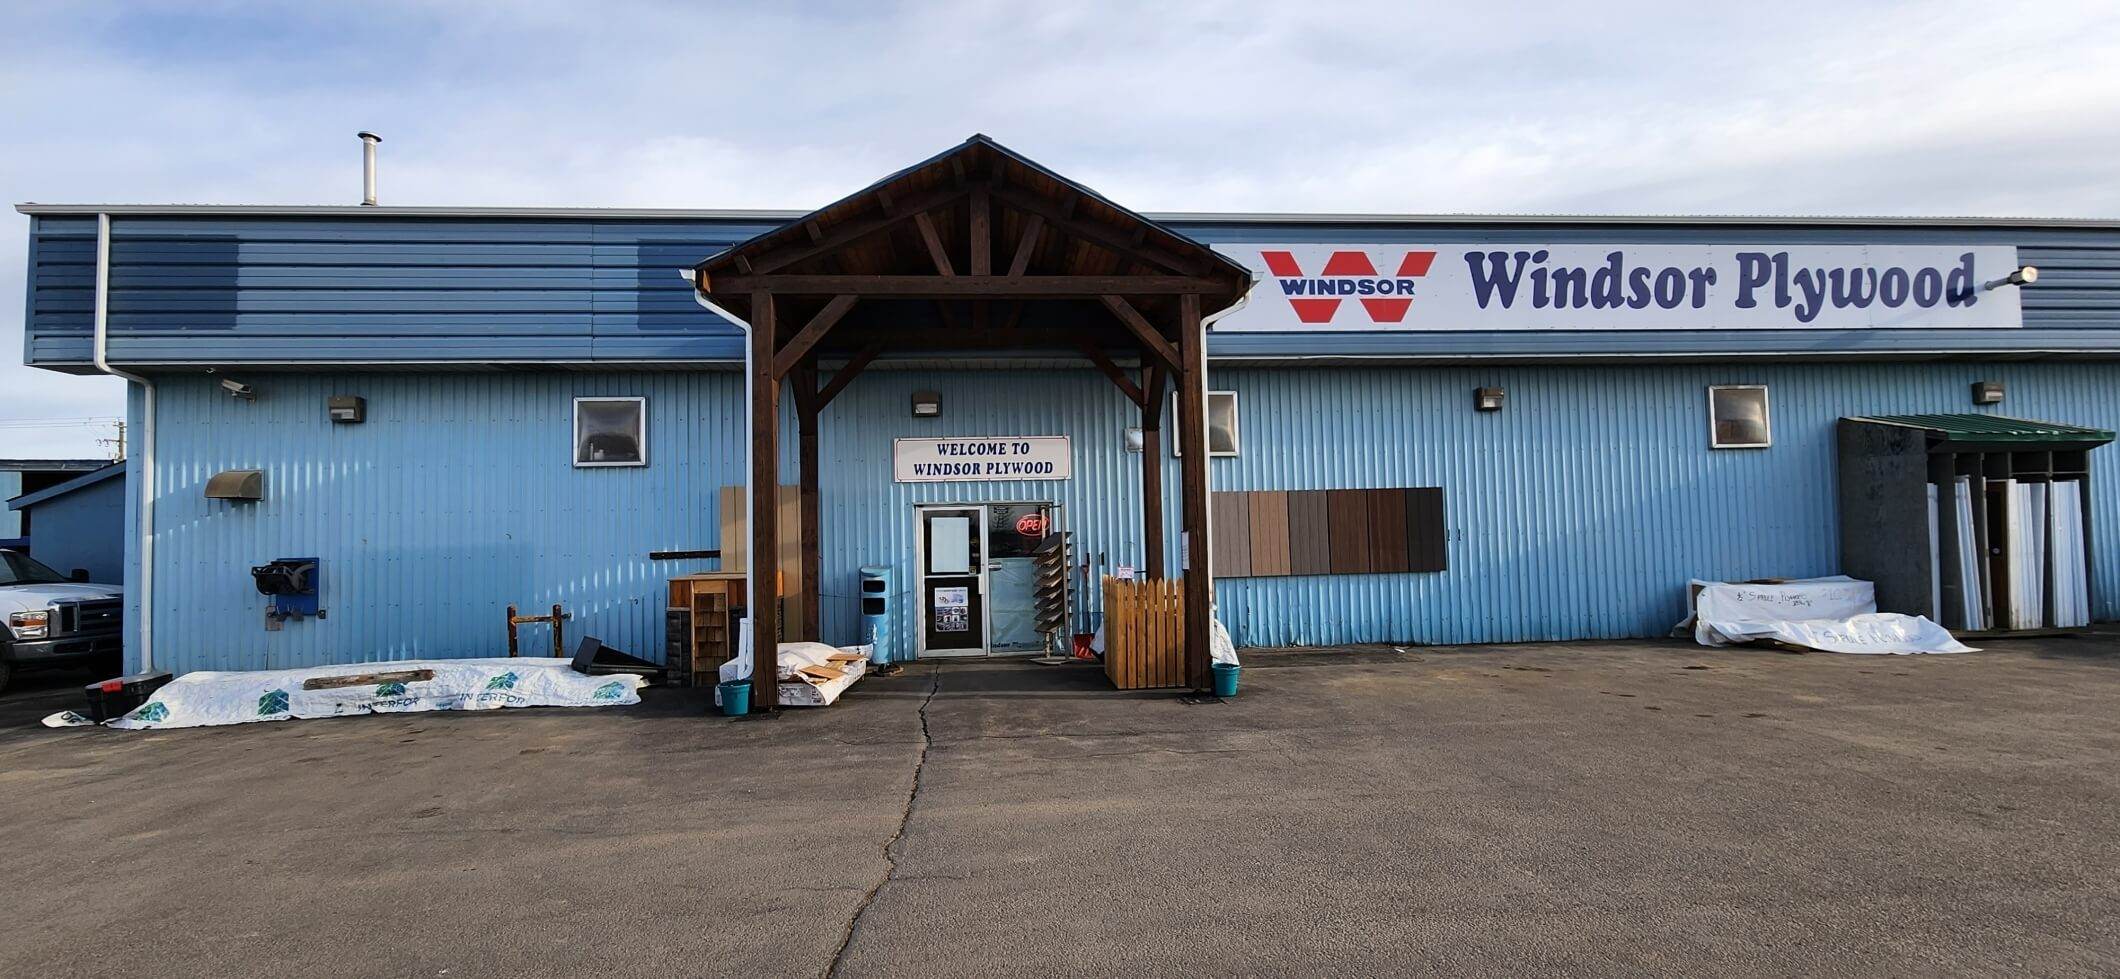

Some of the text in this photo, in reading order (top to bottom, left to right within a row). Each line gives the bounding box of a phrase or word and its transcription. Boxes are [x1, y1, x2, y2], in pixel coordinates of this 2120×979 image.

[1279, 279, 1416, 296] WINDSOR
[1464, 250, 1978, 323] Windsor Plywood
[937, 442, 1030, 456] WELCOME TO
[914, 461, 1054, 476] WINDSOR PLYWOOD
[1018, 519, 1048, 531] OPEN
[357, 697, 420, 712] INTERFOR
[458, 692, 525, 704] INTERFOR
